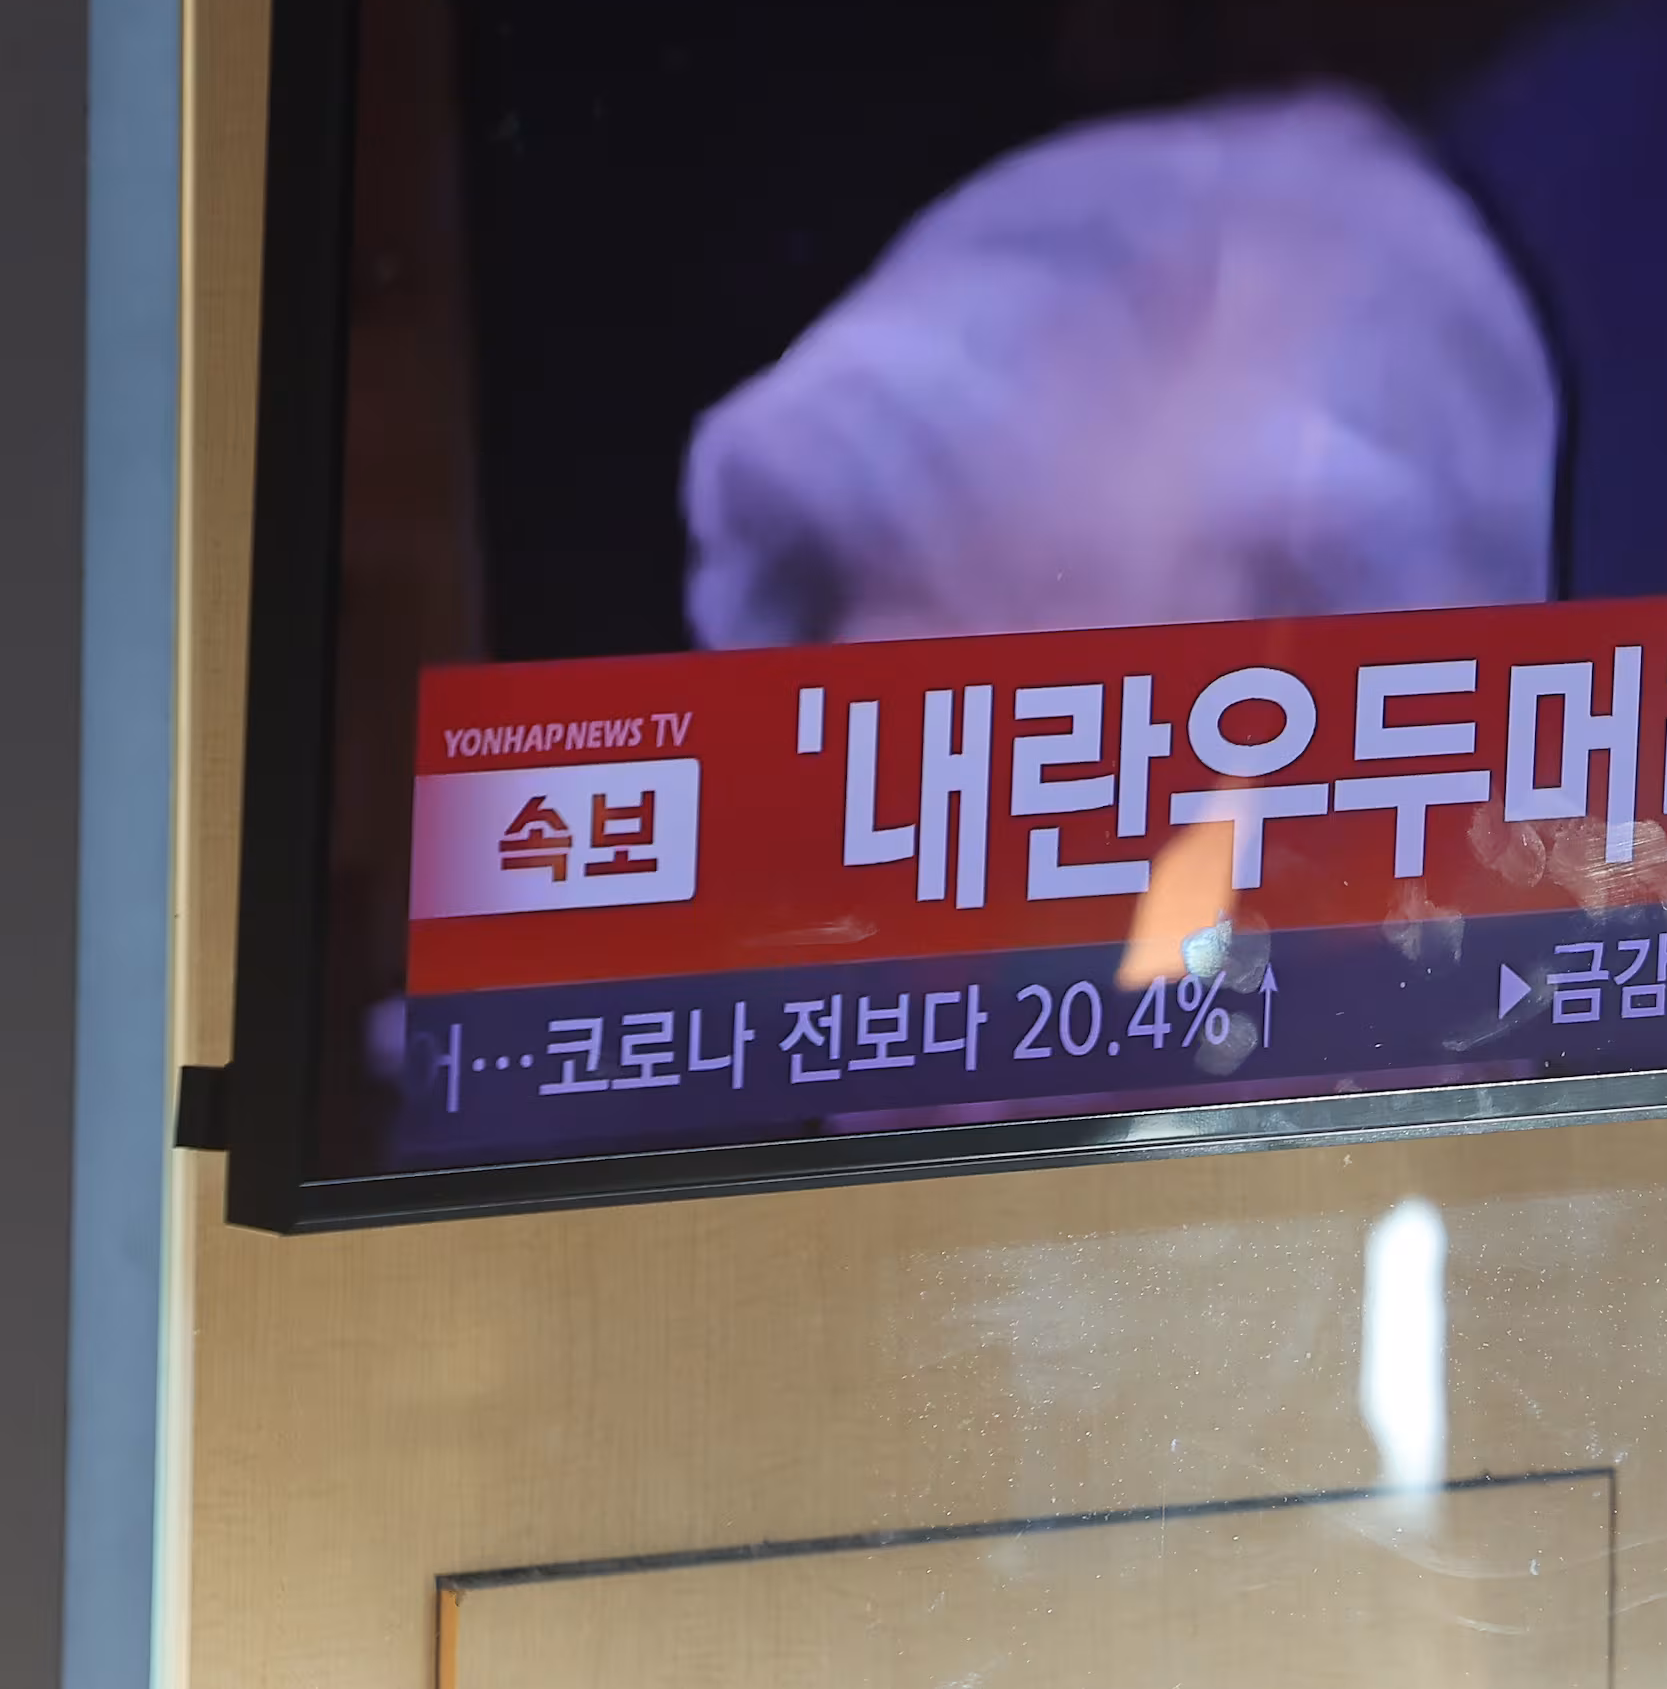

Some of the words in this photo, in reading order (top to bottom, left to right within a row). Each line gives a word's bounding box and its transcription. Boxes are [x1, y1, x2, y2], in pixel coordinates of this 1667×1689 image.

[650, 711, 693, 749] TV
[499, 790, 658, 882] 속보
[778, 983, 988, 1085] 전보다
[1013, 969, 1232, 1061] 20.4%
